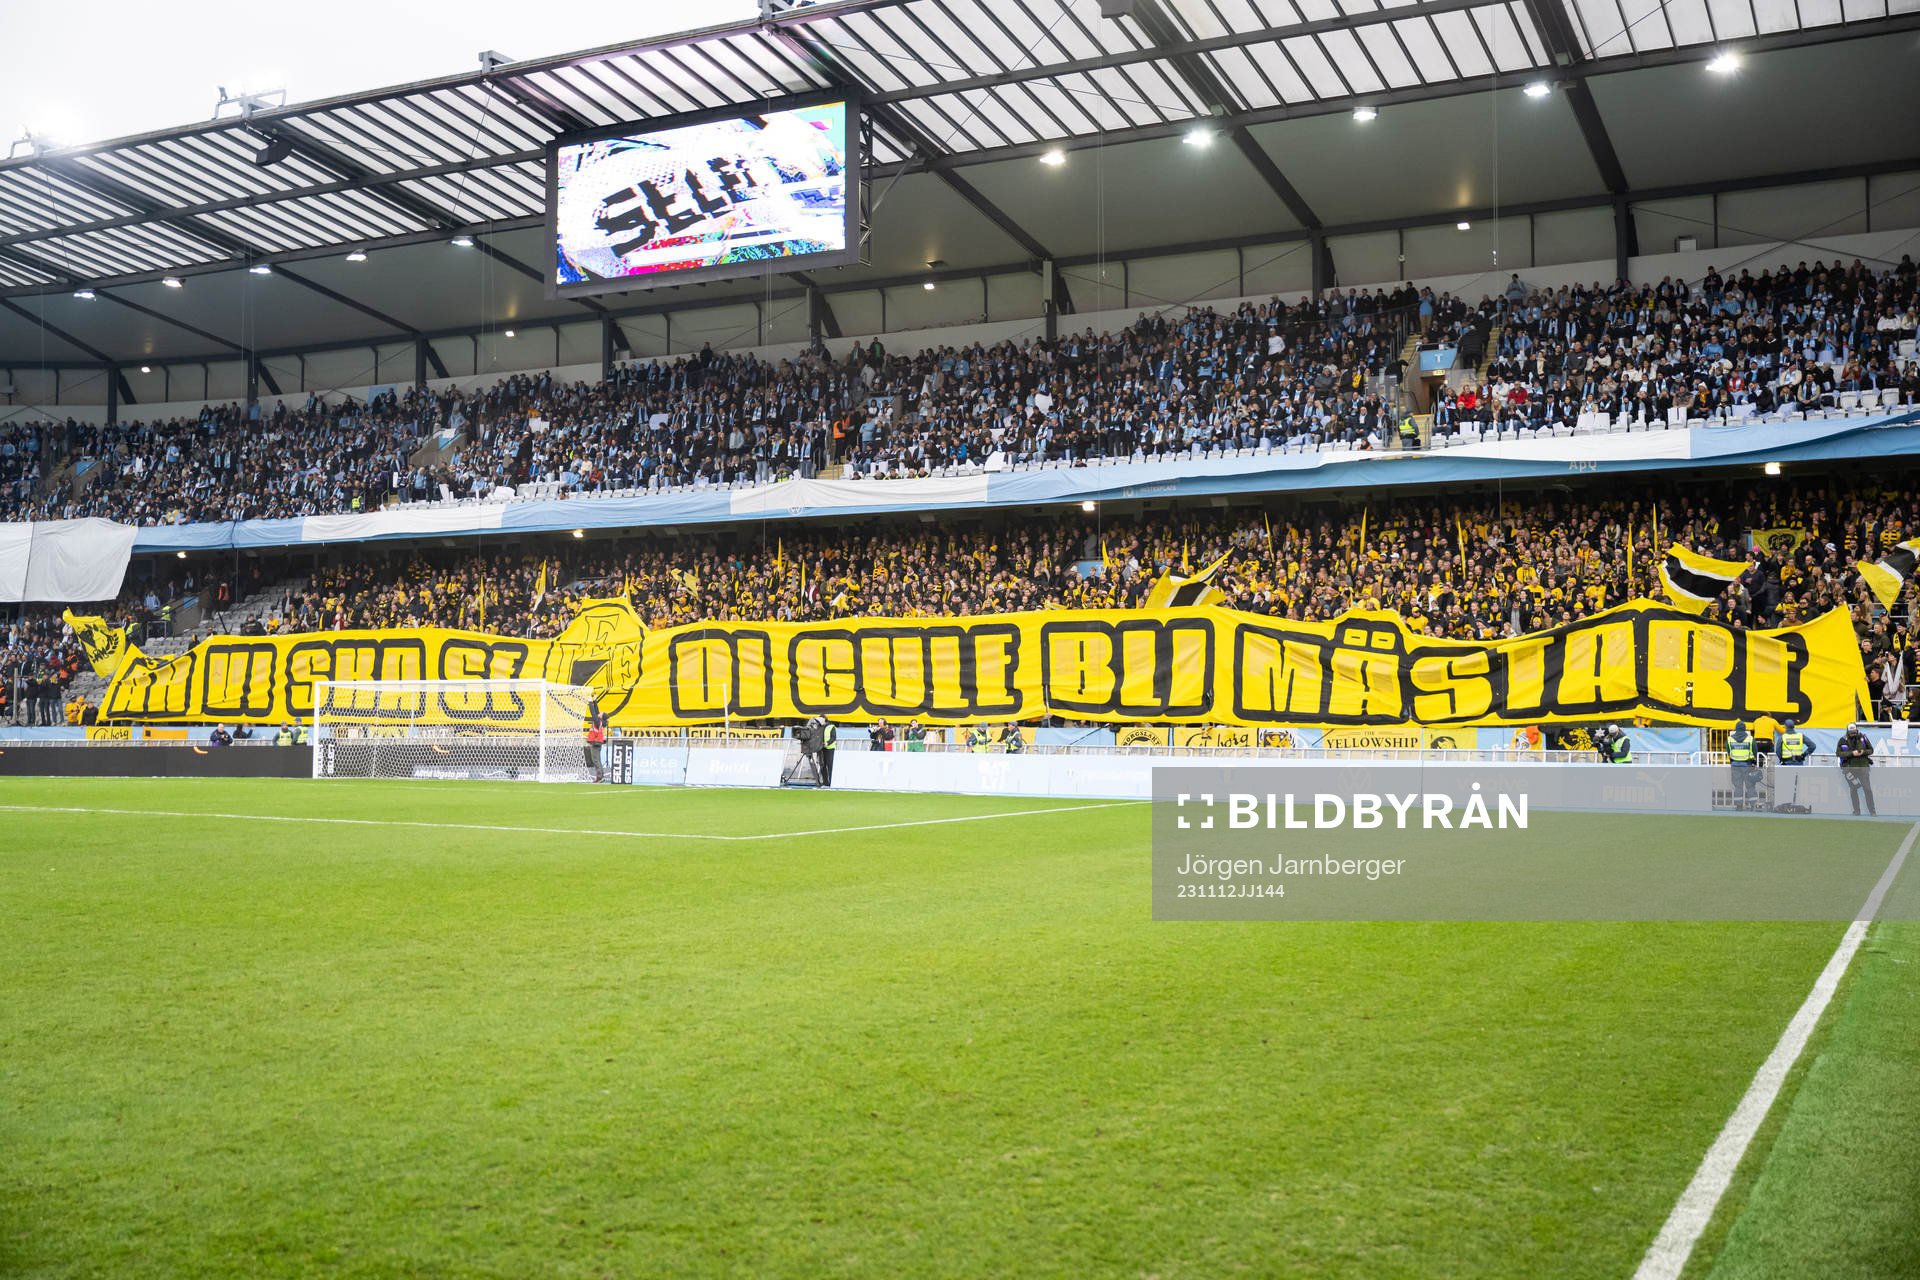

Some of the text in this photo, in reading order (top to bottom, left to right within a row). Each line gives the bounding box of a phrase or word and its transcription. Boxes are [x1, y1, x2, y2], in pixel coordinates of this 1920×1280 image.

[285, 638, 426, 717] SKA
[438, 638, 529, 721] SE
[669, 629, 773, 718] DI
[788, 623, 1023, 718] GULE
[1040, 618, 1215, 716] BLI
[1233, 608, 1812, 725] MÄSTARE
[1327, 737, 1418, 749] YELLOWSHIP
[612, 744, 623, 784] SELECT
[624, 745, 633, 784] SELECT
